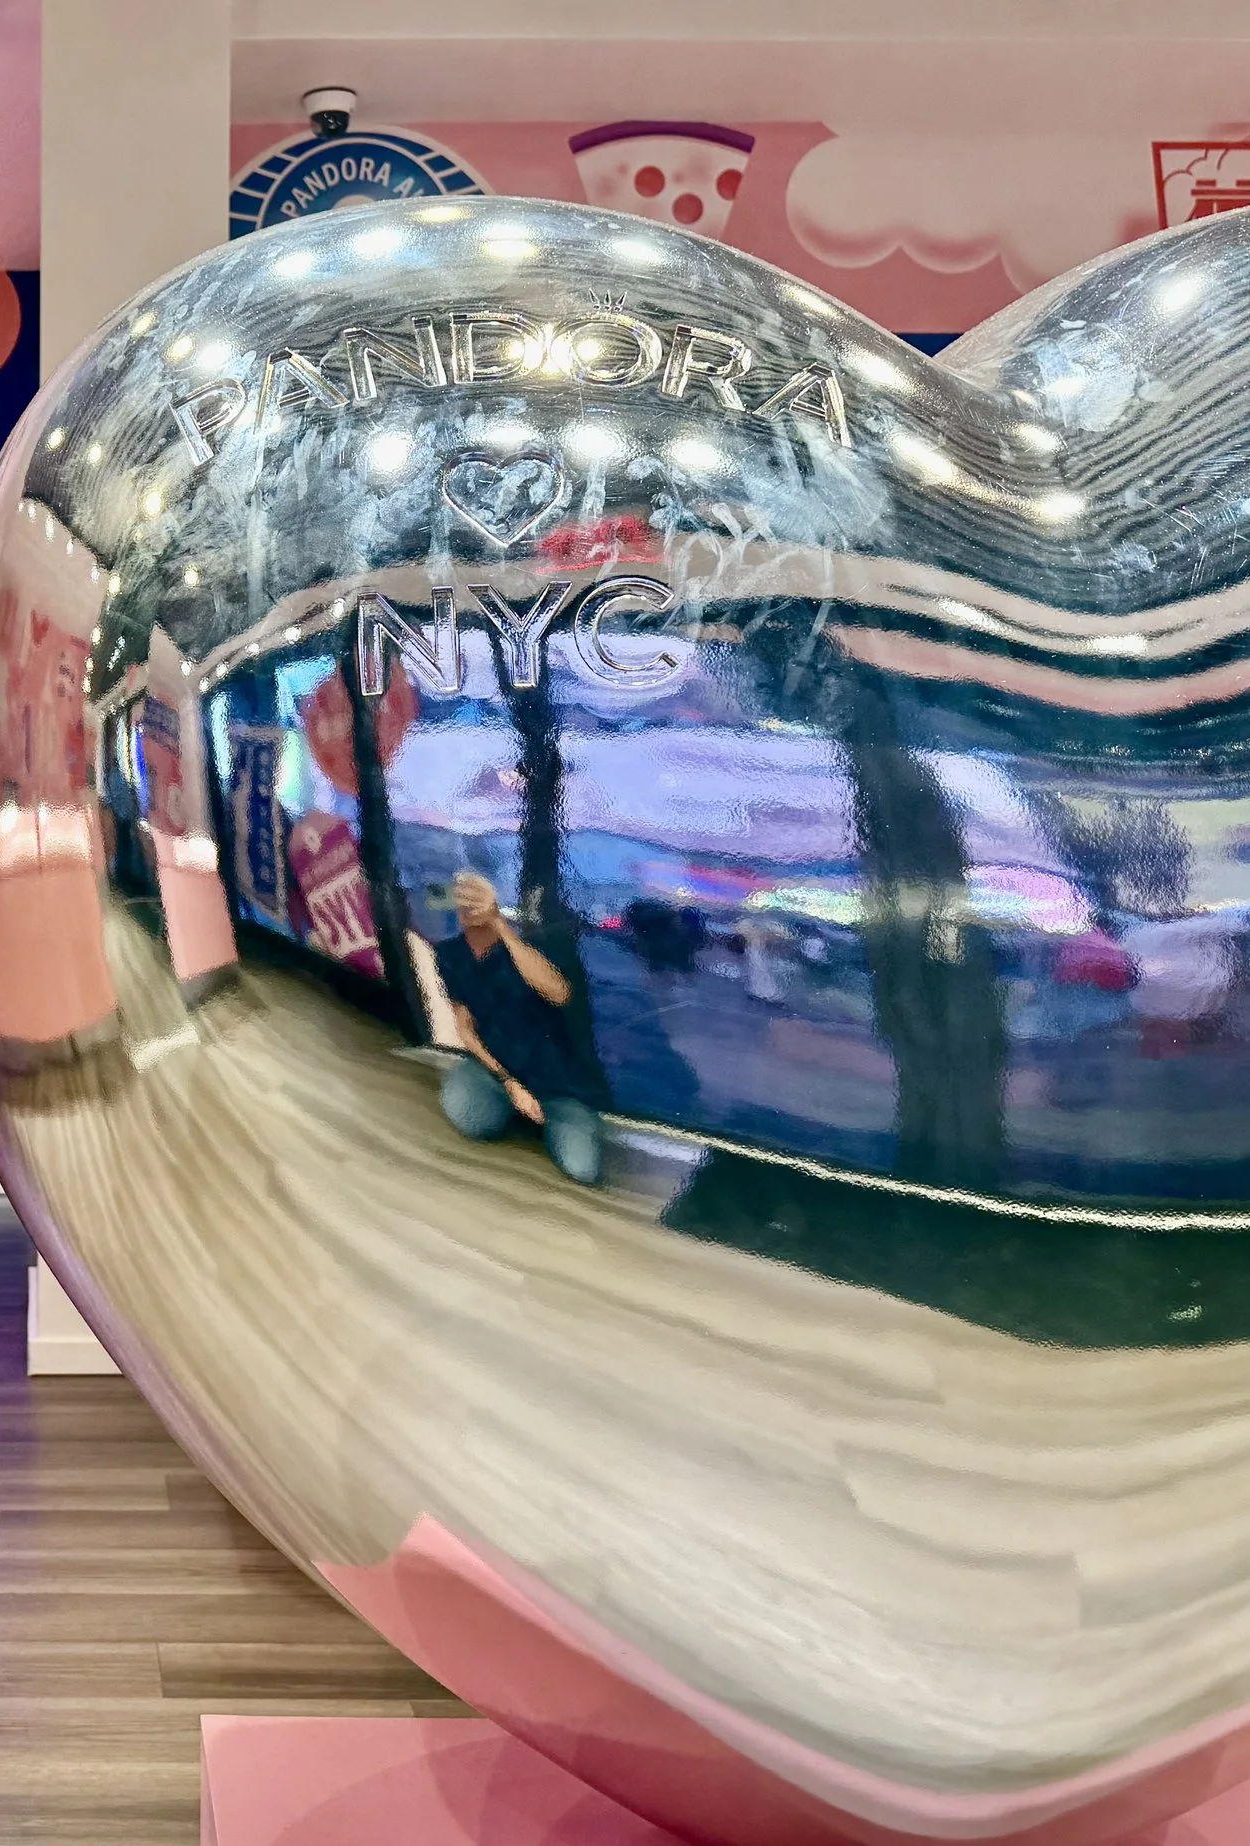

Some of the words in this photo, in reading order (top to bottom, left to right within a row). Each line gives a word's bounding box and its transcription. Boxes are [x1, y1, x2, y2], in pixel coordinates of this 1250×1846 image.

[280, 157, 391, 218] PANDORA
[169, 311, 851, 467] PANDORA
[357, 575, 680, 696] NYC
